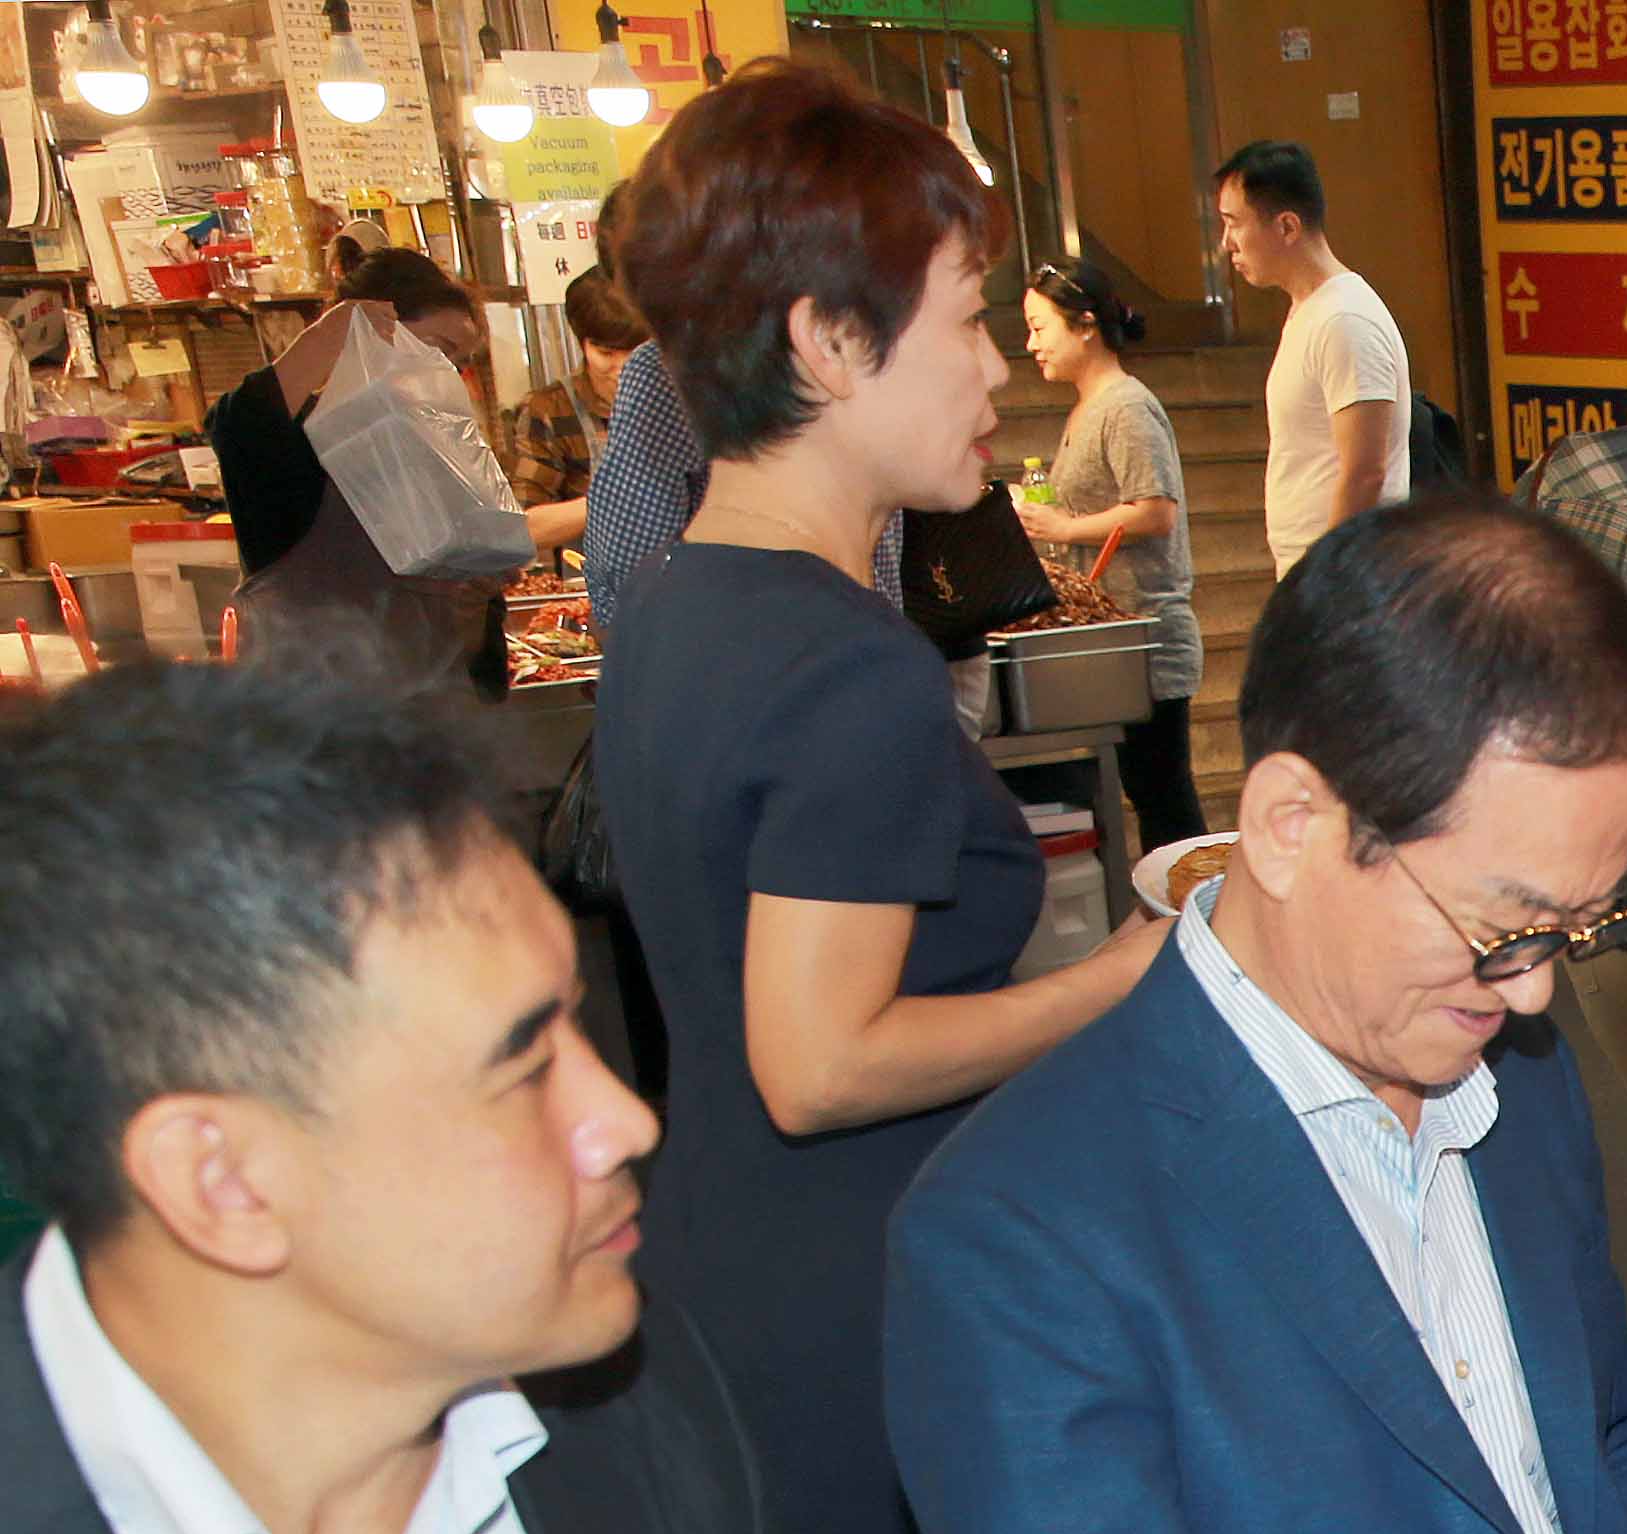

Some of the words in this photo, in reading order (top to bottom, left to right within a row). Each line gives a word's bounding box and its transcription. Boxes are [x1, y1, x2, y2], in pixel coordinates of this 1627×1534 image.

[530, 135, 589, 149] Vacuum
[527, 161, 600, 179] packaging
[538, 185, 600, 201] available
